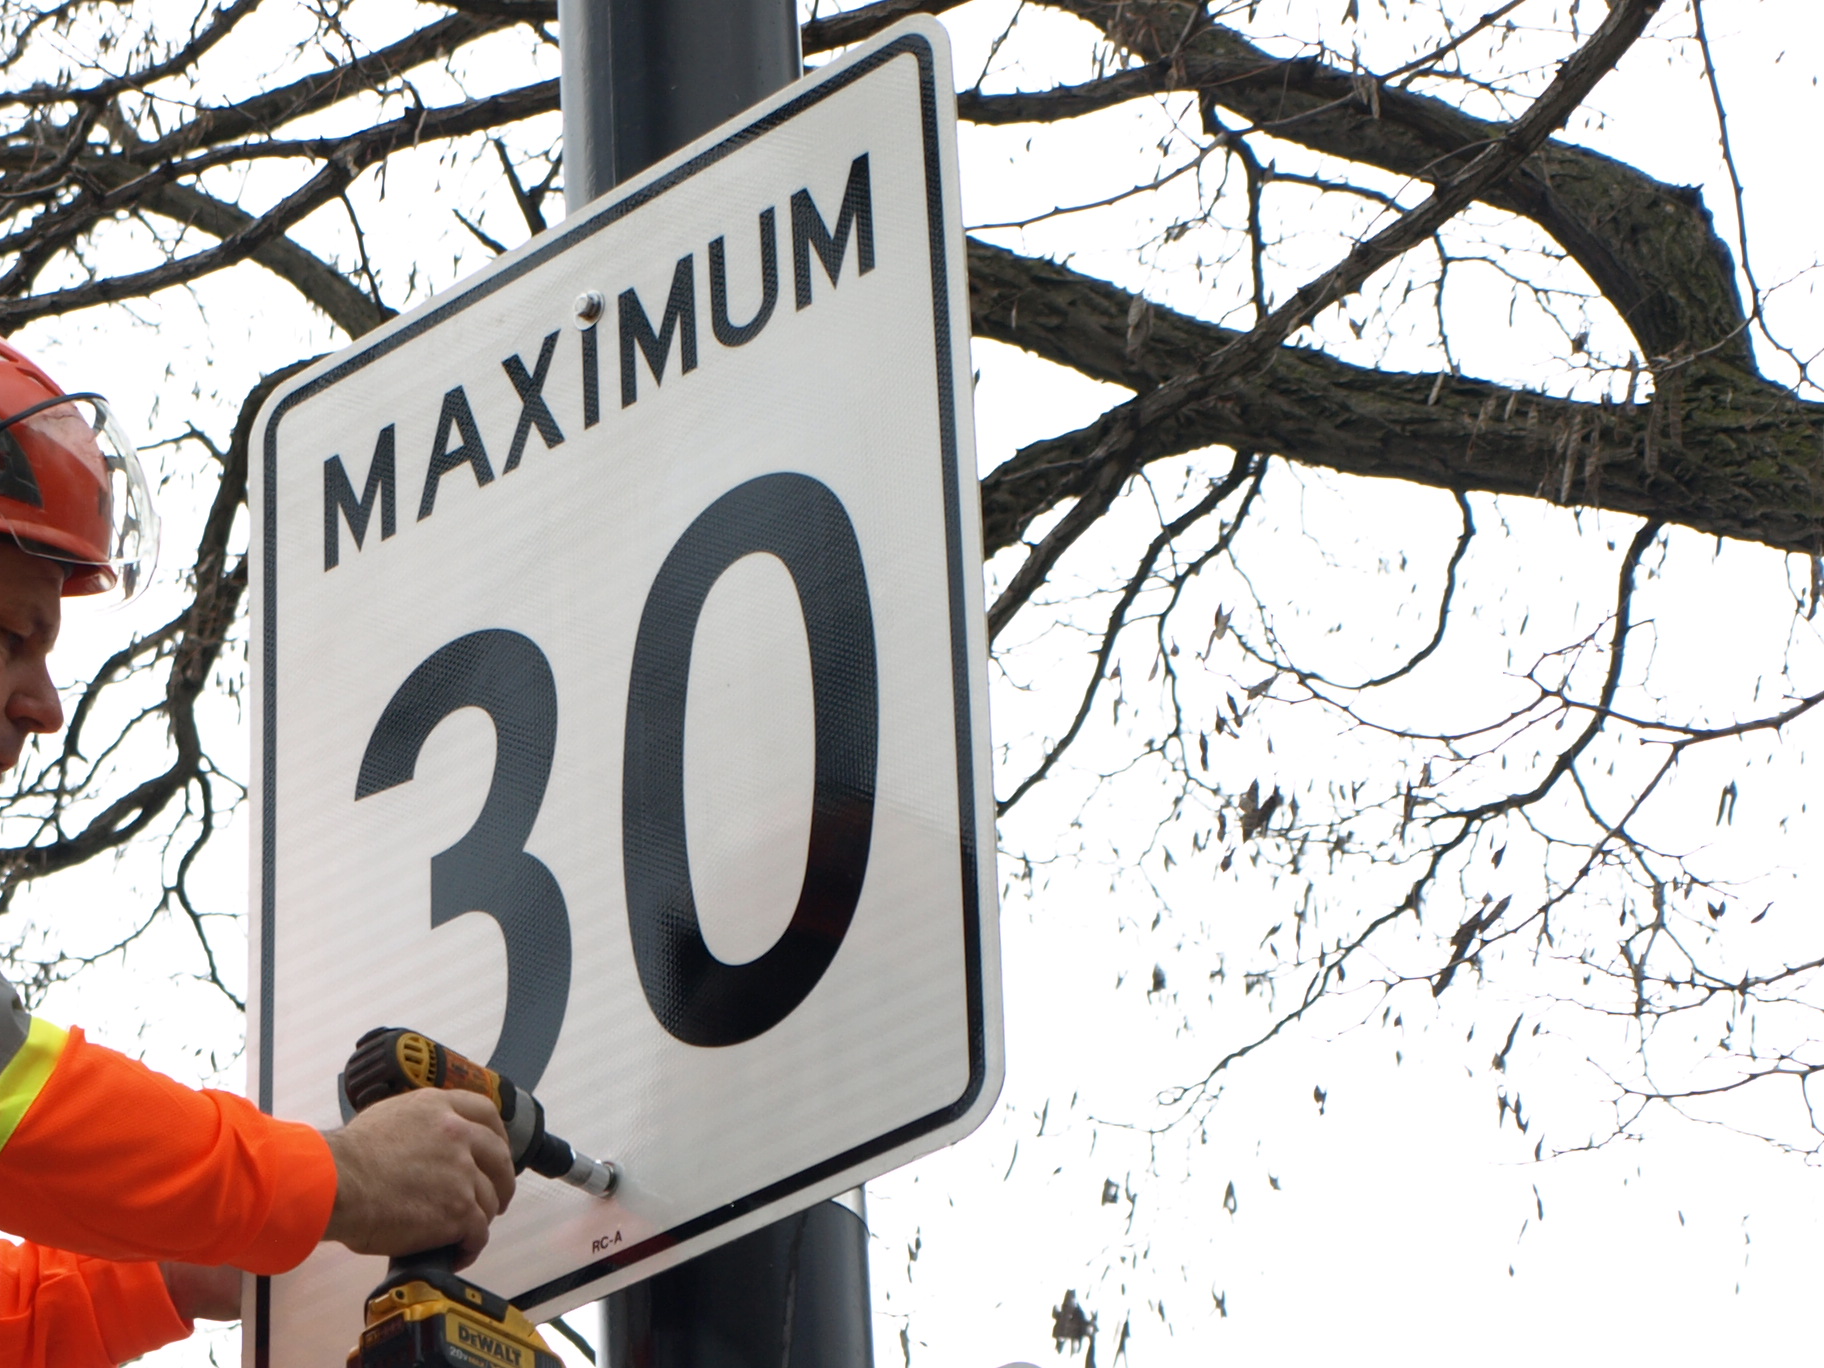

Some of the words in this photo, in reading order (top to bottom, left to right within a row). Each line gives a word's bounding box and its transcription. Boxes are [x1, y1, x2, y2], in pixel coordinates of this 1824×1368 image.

[323, 151, 876, 573] MAXIMUM
[338, 471, 879, 1126] 30
[592, 1230, 622, 1254] RC-A
